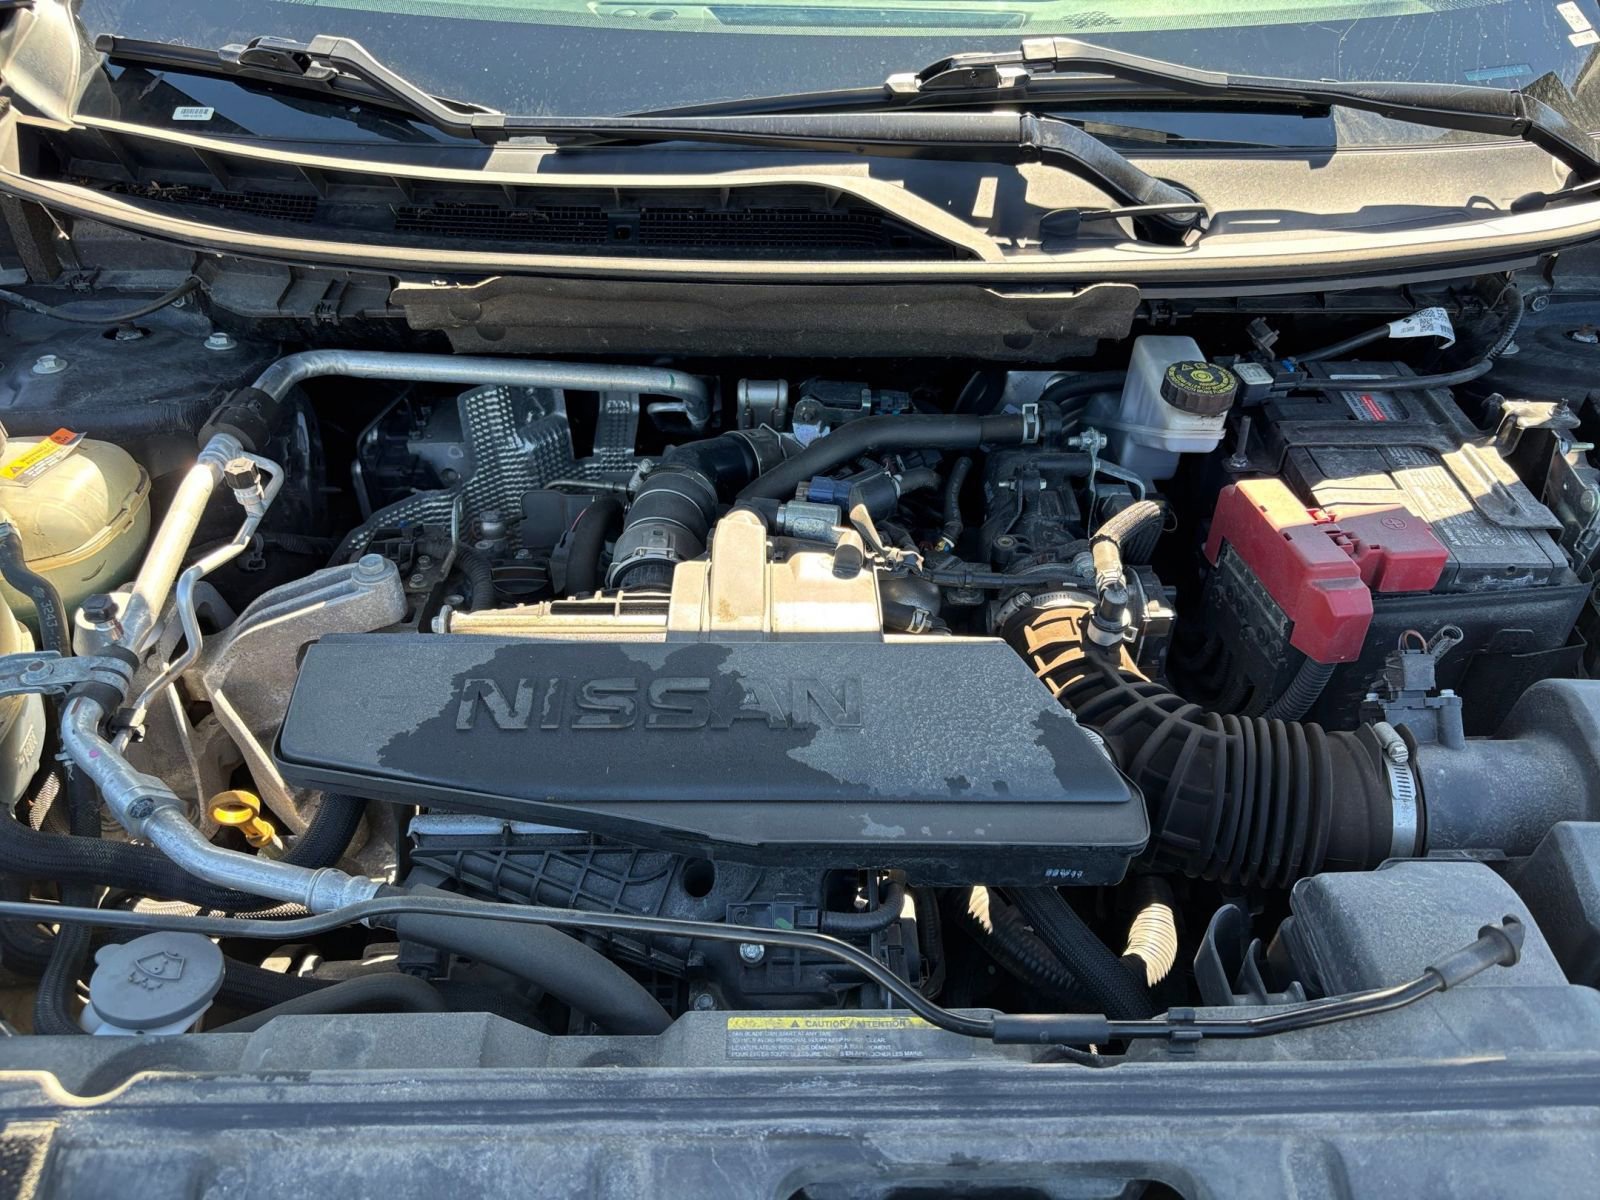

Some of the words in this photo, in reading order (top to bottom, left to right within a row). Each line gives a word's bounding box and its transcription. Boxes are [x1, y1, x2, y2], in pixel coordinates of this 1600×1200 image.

[40, 599, 58, 627] 3243
[455, 676, 863, 730] NISSAN
[804, 1019, 846, 1028] CAUTION
[856, 1019, 906, 1028] ATTENTION
